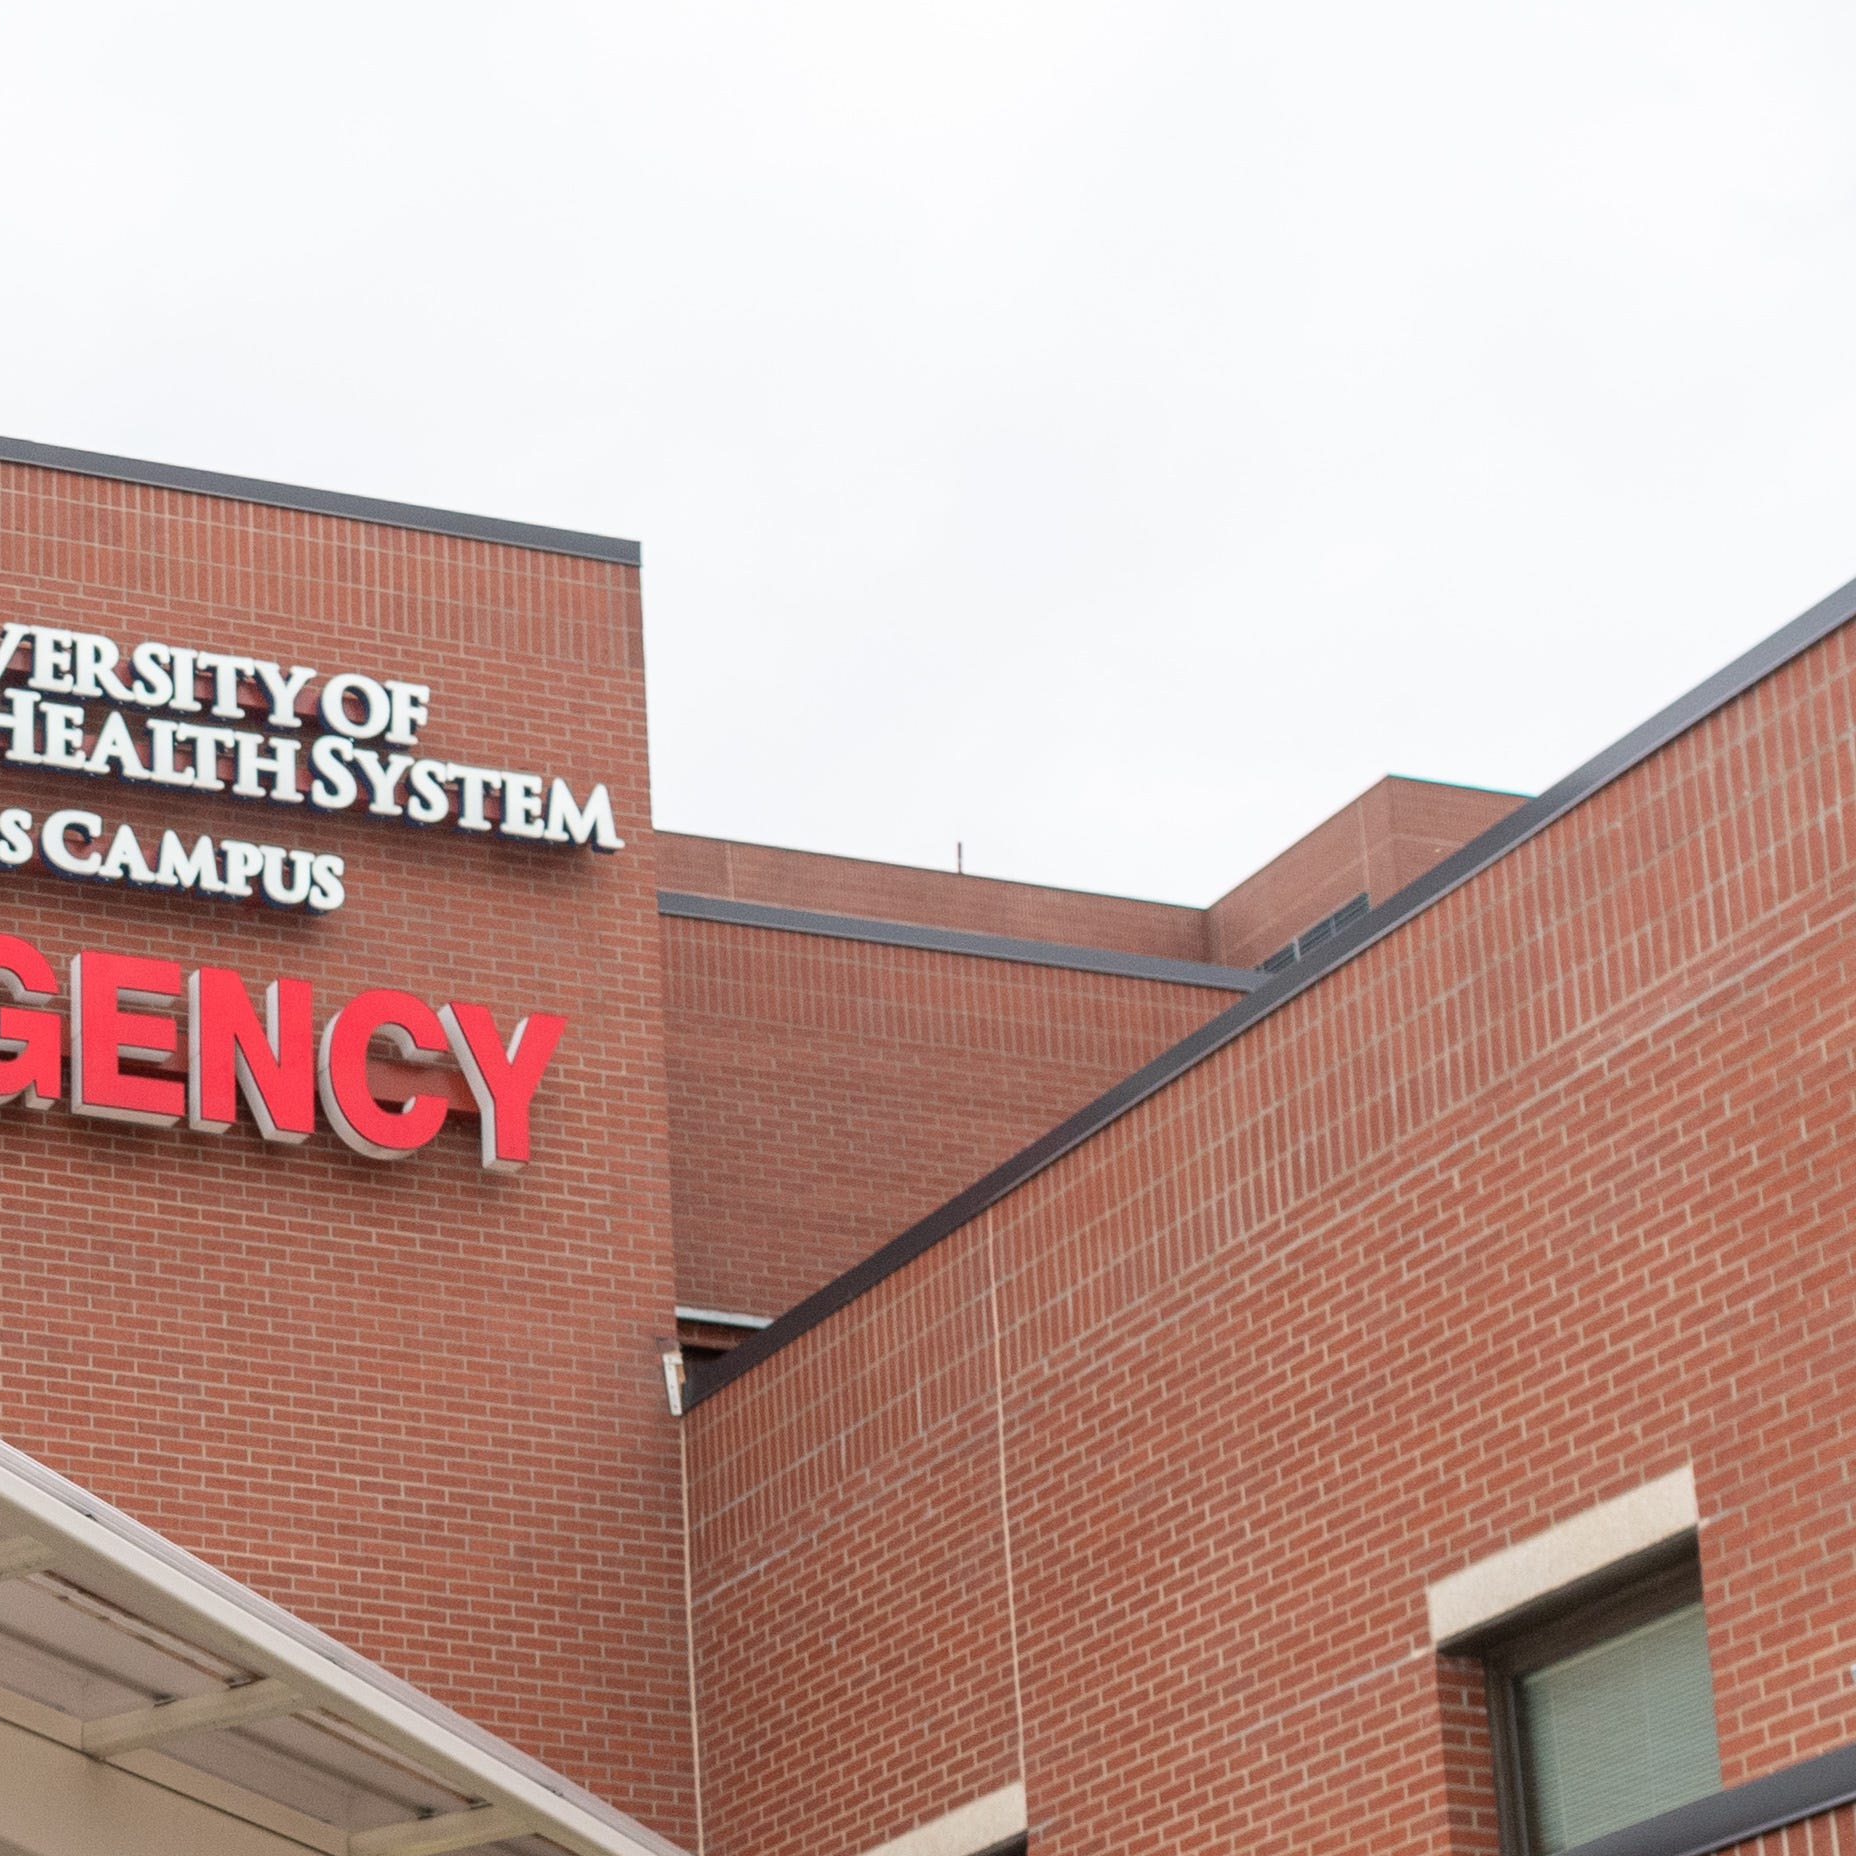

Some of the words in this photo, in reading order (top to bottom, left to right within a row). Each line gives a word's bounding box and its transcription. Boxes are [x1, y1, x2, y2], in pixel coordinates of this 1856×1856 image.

[322, 671, 429, 746] OF
[308, 733, 624, 852] SYSTEM
[42, 810, 346, 911] CAMPUS
